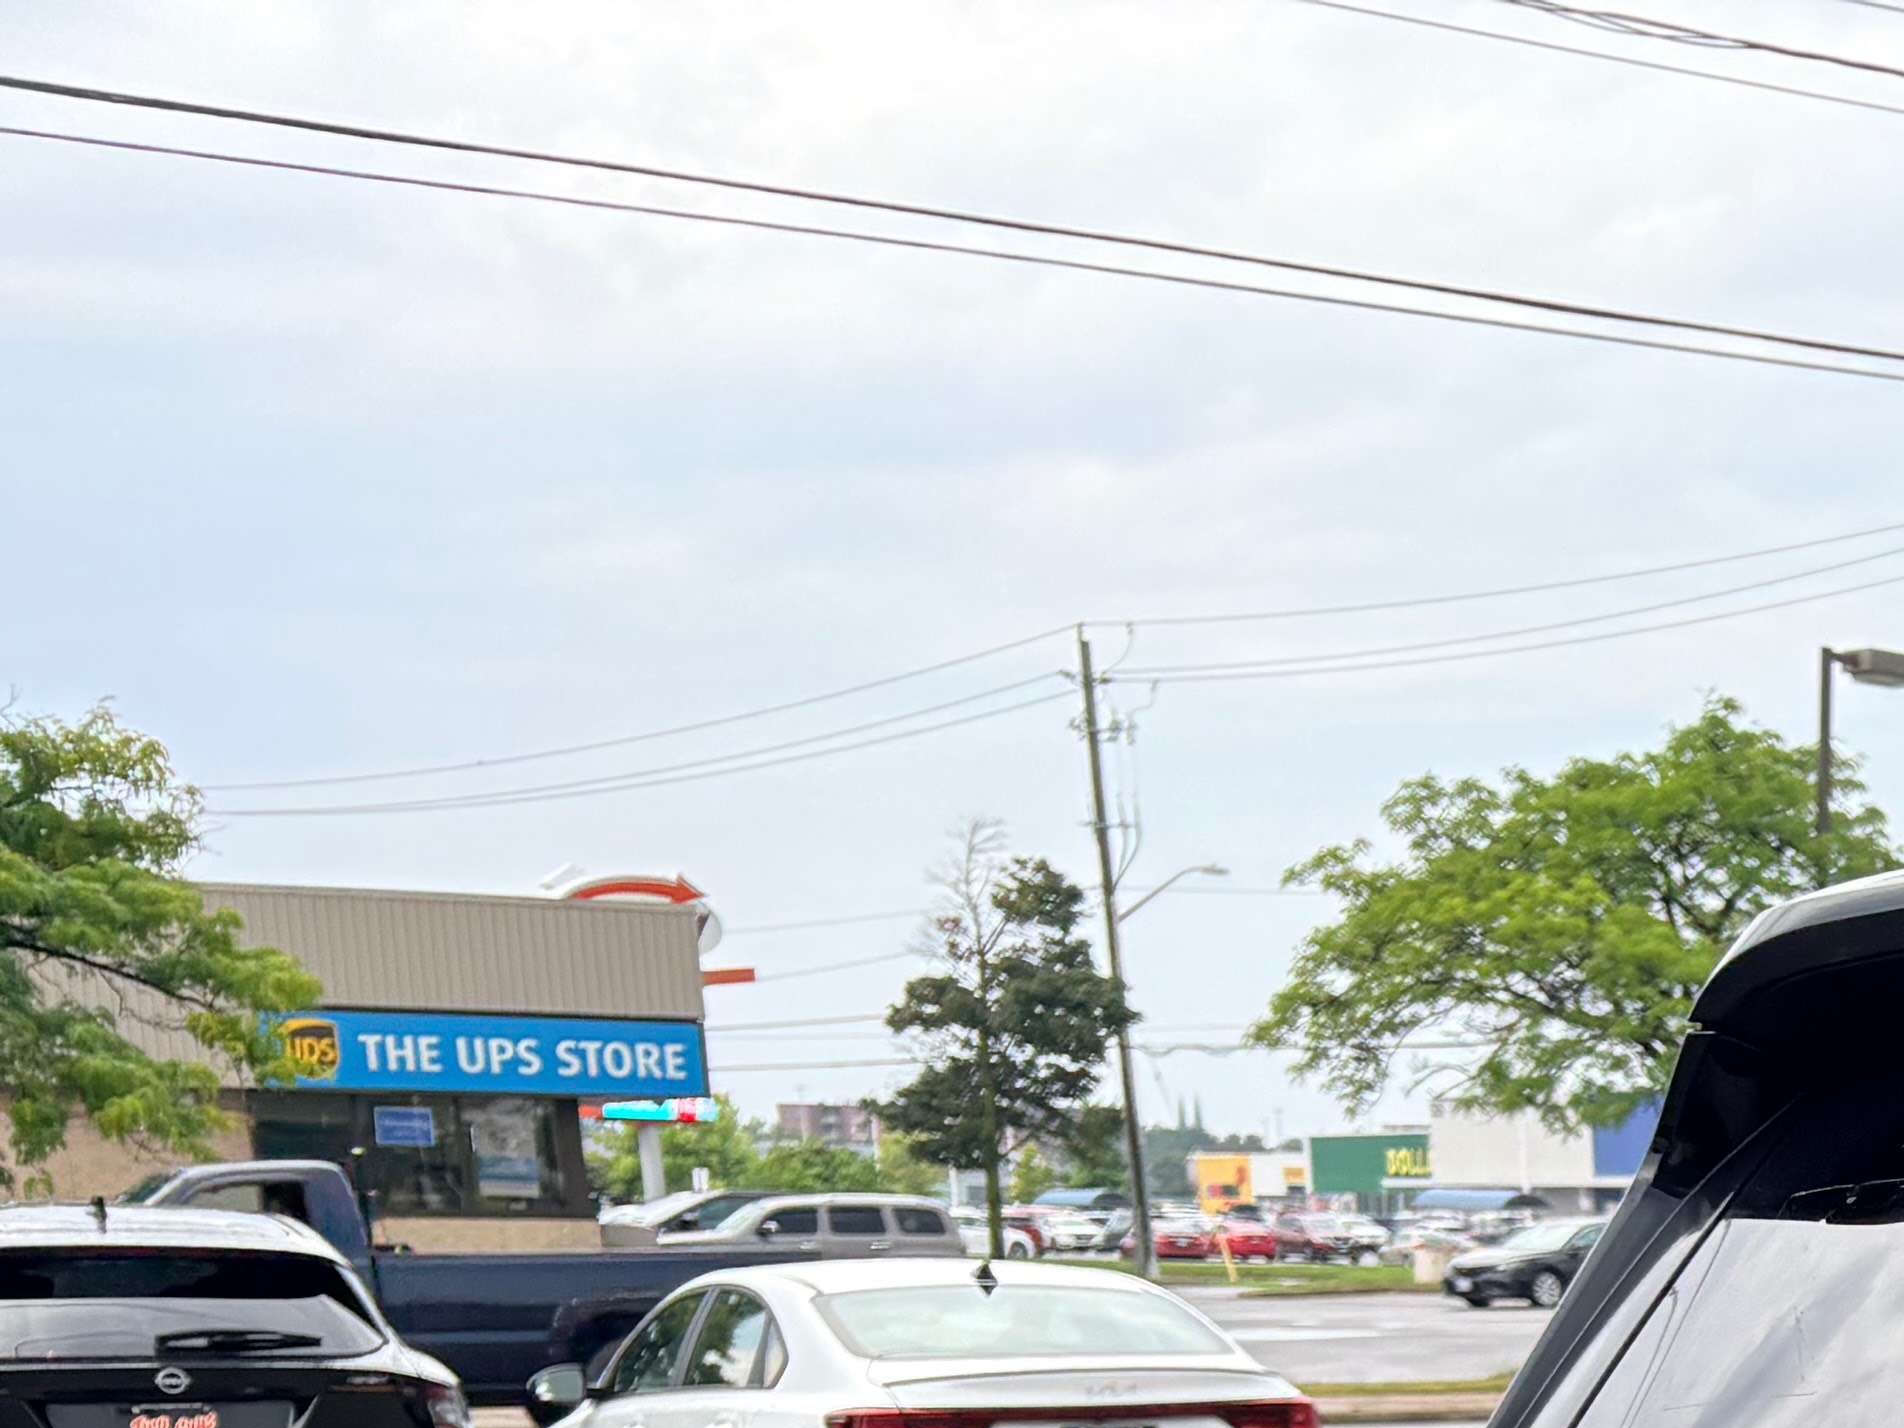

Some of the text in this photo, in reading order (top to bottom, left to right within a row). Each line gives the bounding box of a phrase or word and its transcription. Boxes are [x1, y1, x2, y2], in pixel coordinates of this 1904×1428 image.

[358, 1034, 688, 1080] THE UPS STORE
